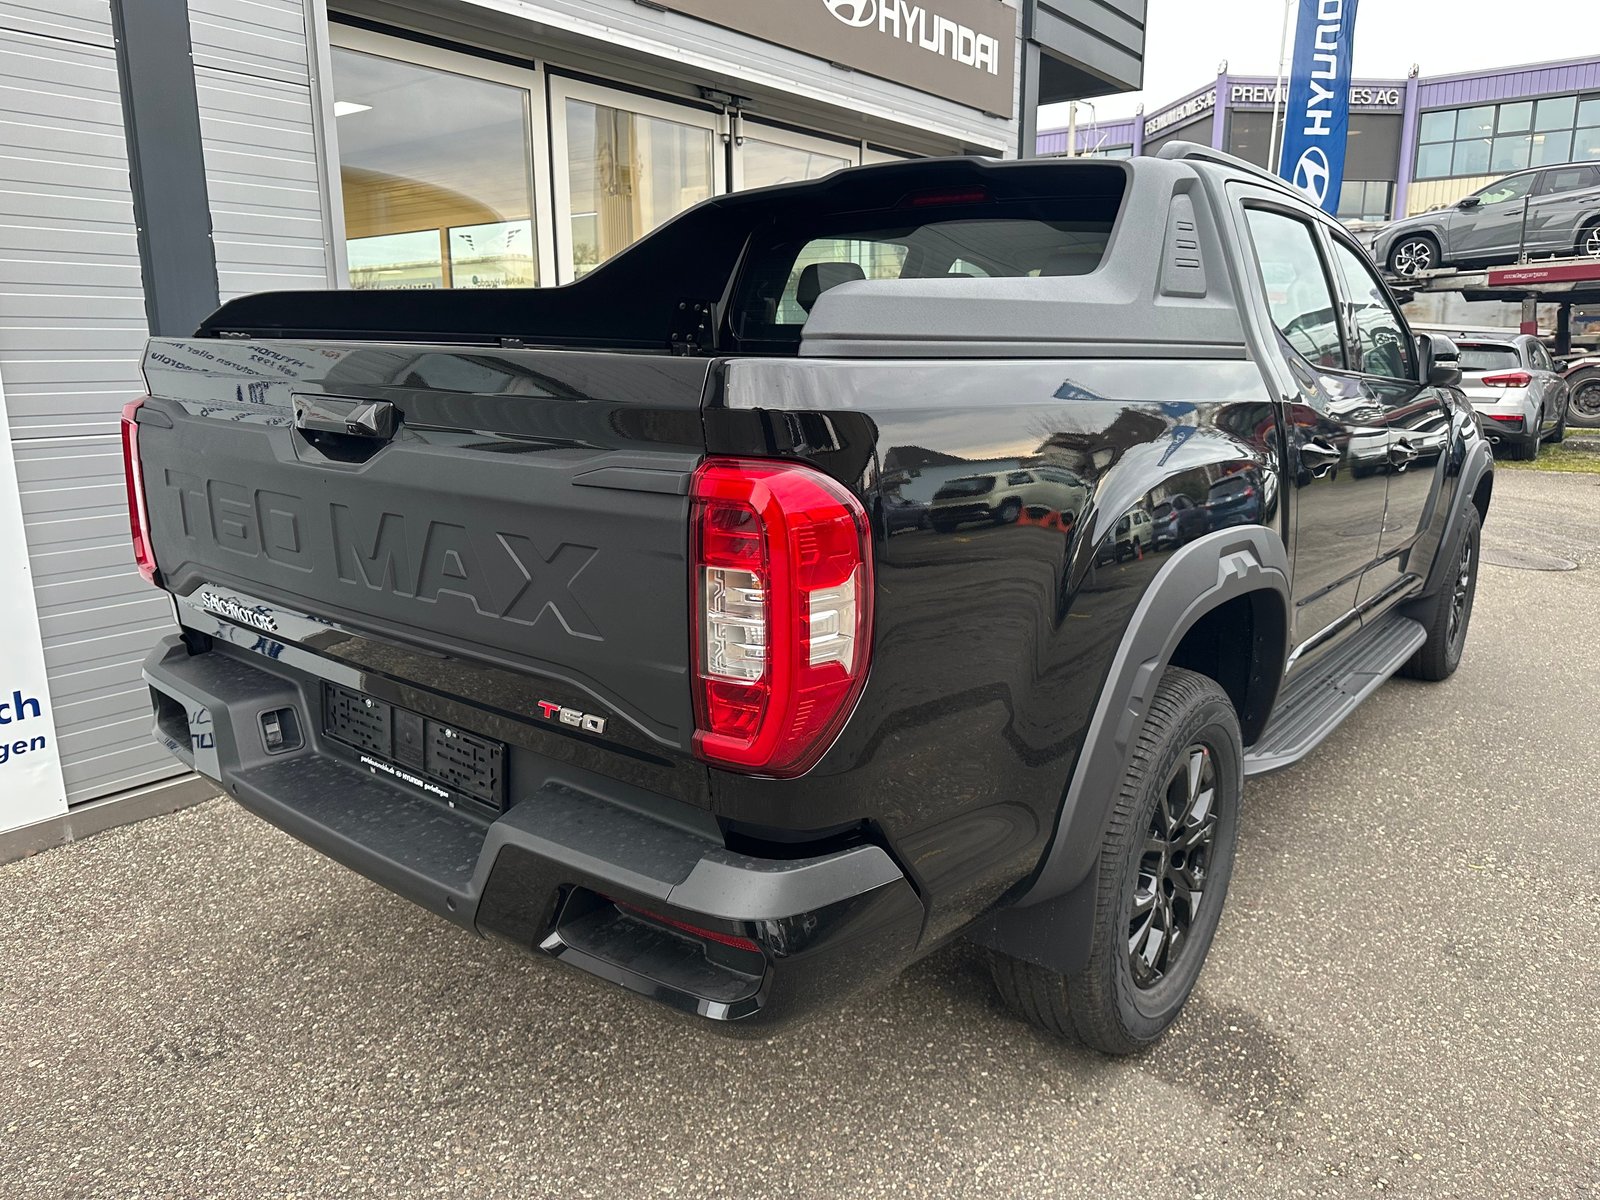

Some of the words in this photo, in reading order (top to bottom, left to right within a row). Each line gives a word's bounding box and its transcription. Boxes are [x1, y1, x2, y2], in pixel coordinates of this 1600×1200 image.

[878, 0, 999, 76] HYUNDAI
[1303, 0, 1343, 136] HYUND
[1374, 89, 1399, 105] AG
[164, 468, 314, 573] T60
[329, 502, 605, 641] MAX
[537, 700, 607, 734] T60
